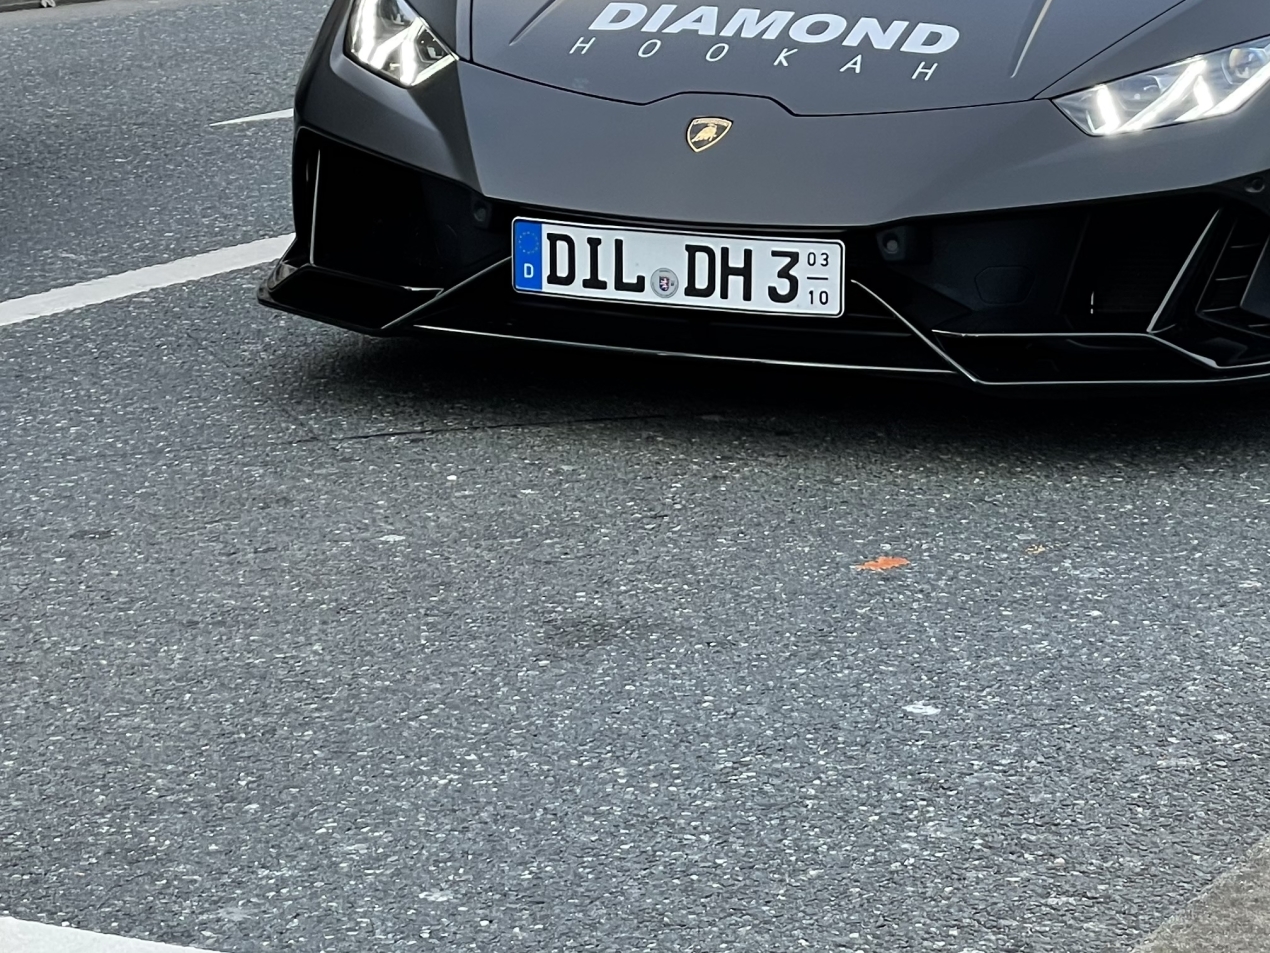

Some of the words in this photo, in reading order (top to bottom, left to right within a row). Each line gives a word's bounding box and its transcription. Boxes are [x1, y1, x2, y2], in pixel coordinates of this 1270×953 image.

[588, 1, 960, 55] DIAMOND
[569, 36, 939, 82] HOOKAH
[523, 263, 534, 279] D
[546, 232, 646, 293] DIL
[684, 244, 753, 302] DH
[767, 249, 800, 304] 3
[806, 251, 829, 267] 03
[808, 290, 829, 305] 10
